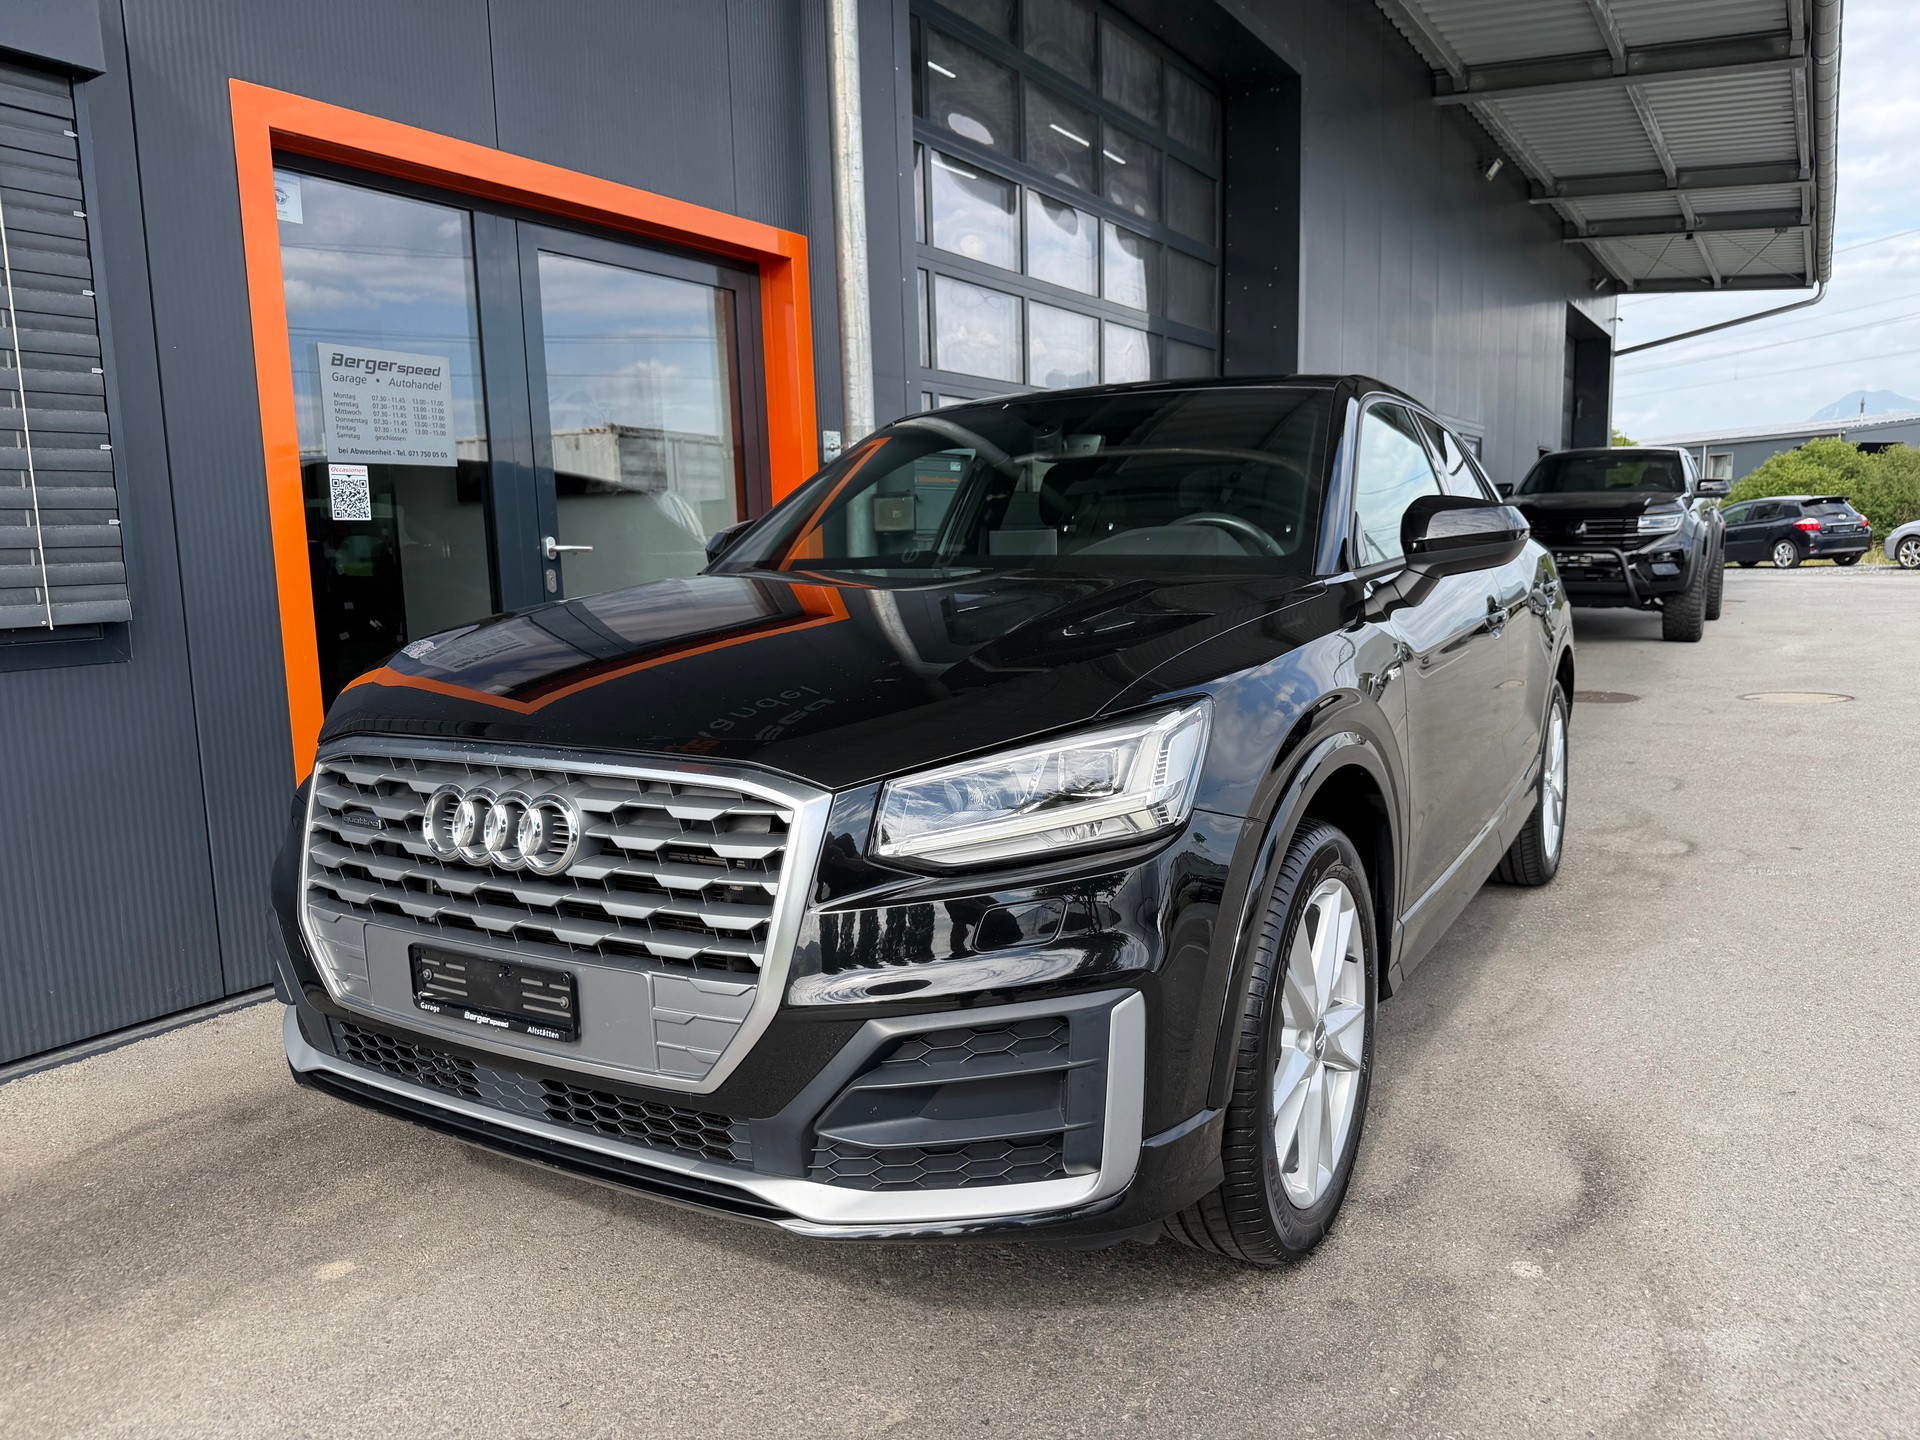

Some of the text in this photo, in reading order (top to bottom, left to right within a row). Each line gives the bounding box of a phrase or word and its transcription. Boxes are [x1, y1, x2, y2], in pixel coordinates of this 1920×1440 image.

[331, 352, 441, 377] Bergerspeed
[331, 372, 442, 391] Garage Autohandel
[333, 391, 356, 401] Montag
[333, 400, 359, 409] Dienstag
[335, 408, 362, 416] Mittwoch
[336, 416, 368, 425] Donnerstag
[336, 424, 356, 432] Freitag
[337, 432, 360, 440] Samstag
[350, 448, 392, 456] Abwesenheit
[420, 1001, 560, 1039] Garage Bergerspeed Altstätten
